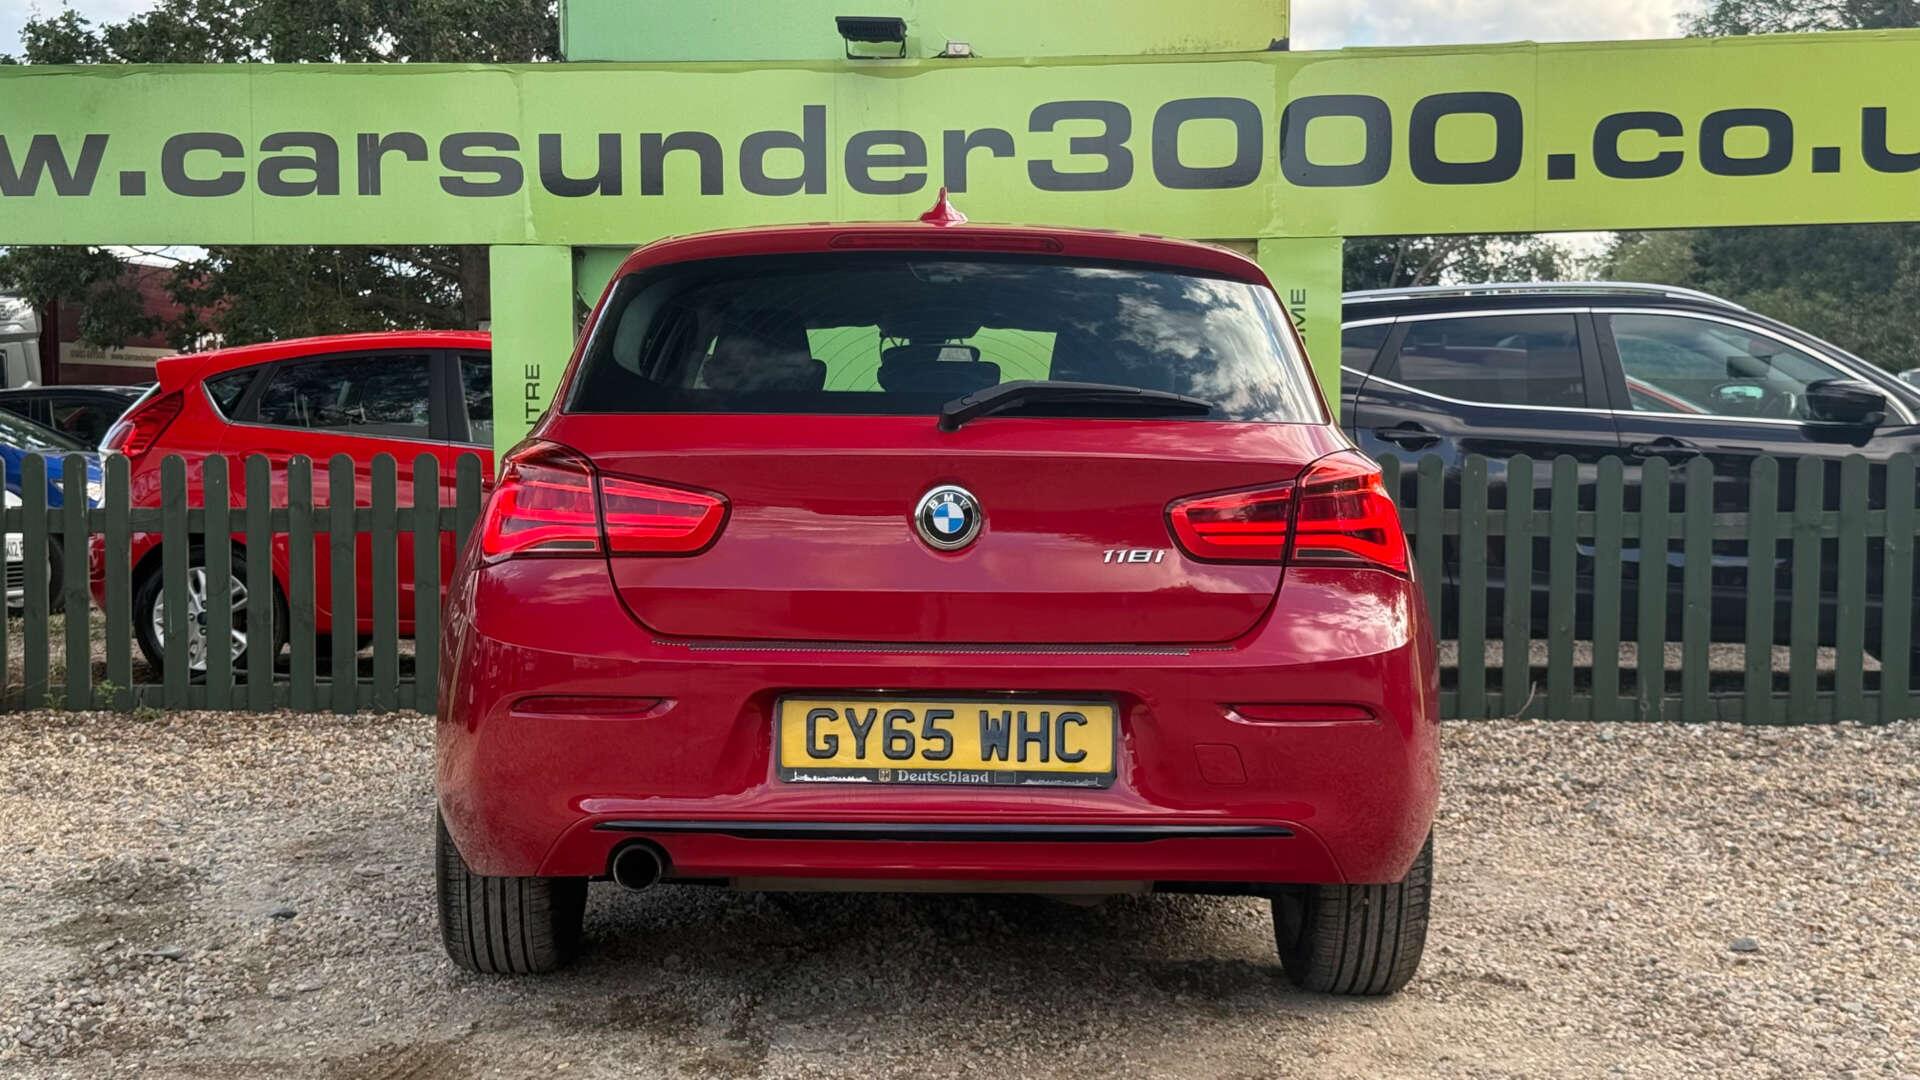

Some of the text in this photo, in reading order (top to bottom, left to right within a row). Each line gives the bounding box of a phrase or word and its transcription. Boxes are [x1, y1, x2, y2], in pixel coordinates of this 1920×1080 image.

[928, 493, 972, 510] BMW
[806, 707, 1088, 764] GY65 WHC
[898, 770, 989, 783] Deutschland
